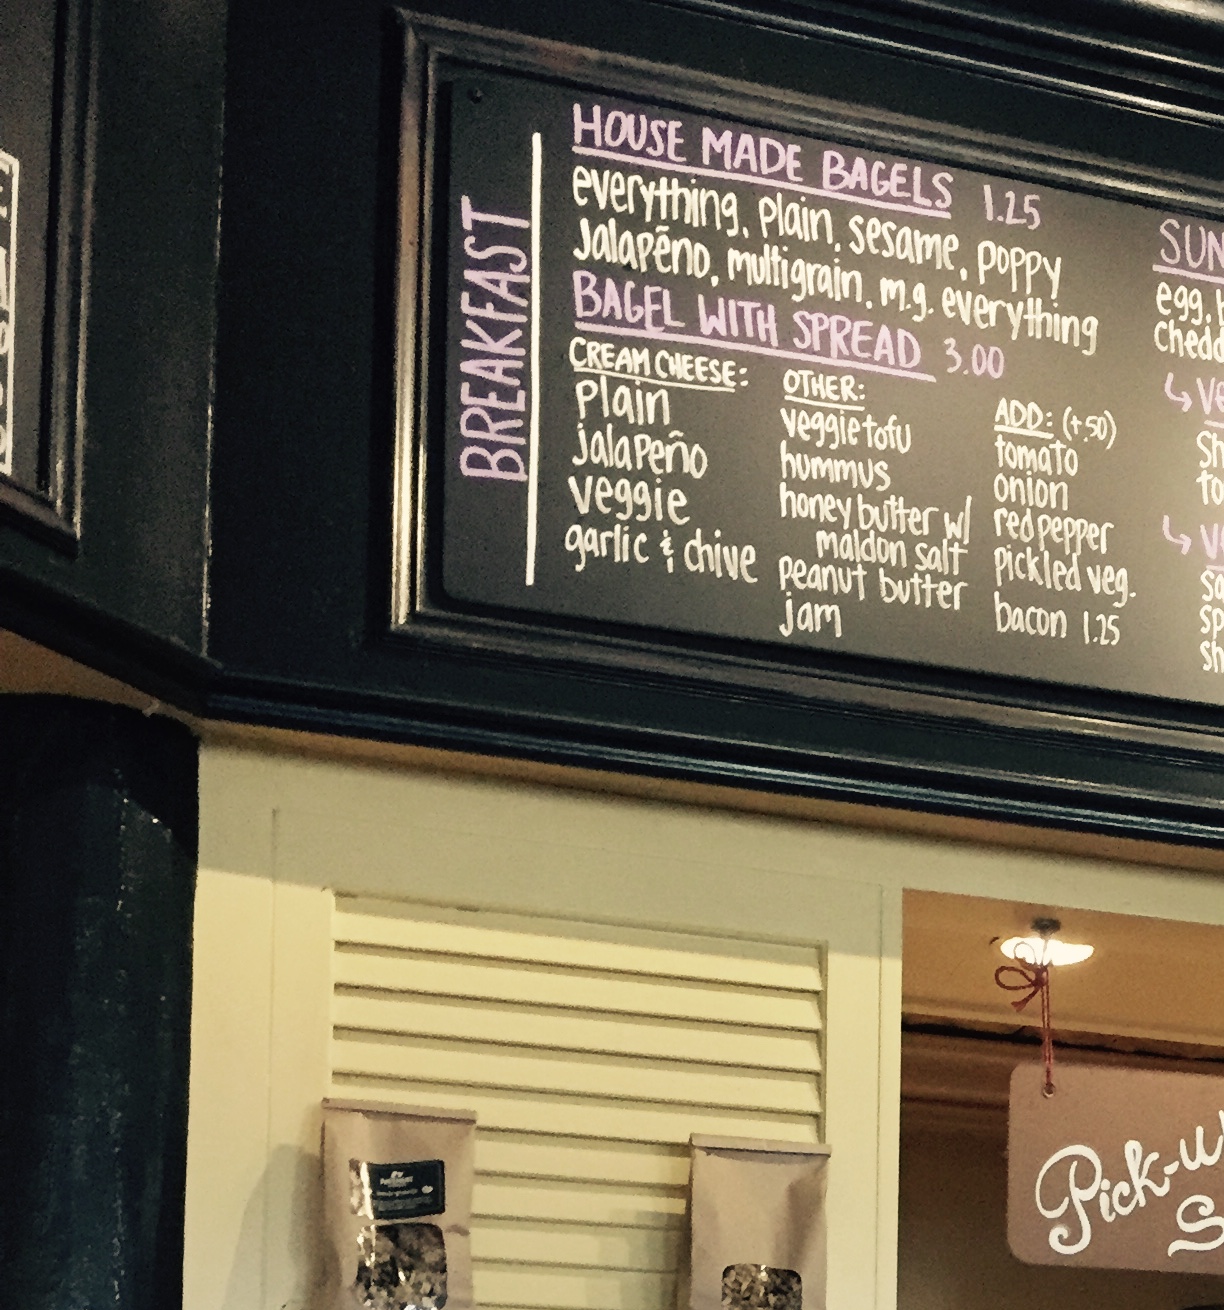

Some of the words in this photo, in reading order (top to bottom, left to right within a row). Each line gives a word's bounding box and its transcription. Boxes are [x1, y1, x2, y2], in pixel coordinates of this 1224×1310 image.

[573, 103, 686, 161] HOUSE
[702, 127, 802, 182] MADE
[822, 150, 954, 209] BAGELS
[984, 184, 1041, 230] 1.25
[978, 240, 1061, 299] poppy
[459, 194, 529, 482] BREAKFAST
[573, 270, 685, 330] BAGEL
[699, 294, 778, 346] WITH
[793, 310, 921, 369] SPREAD
[944, 338, 1005, 379] 3.00
[942, 286, 1098, 357] everything
[569, 337, 649, 375] CREAM
[655, 351, 749, 386] CHEESE:
[783, 369, 865, 401] OTHER:
[780, 407, 858, 449] veggie
[862, 413, 912, 453] tofu
[994, 397, 1053, 429] ADD:
[780, 440, 891, 491] hummus
[995, 434, 1079, 475] tomato
[568, 475, 690, 525] veggie
[780, 482, 852, 530] honey
[858, 494, 939, 535] butter
[994, 471, 1068, 510] onion
[564, 524, 649, 572] garlic
[684, 528, 758, 583] chive
[816, 528, 906, 568] maldon
[915, 538, 968, 575] salt
[994, 507, 1034, 542] red
[1038, 513, 1114, 555] pepper
[779, 555, 867, 600] peanut
[879, 568, 968, 609] butter
[994, 545, 1081, 592] pickled
[1087, 565, 1137, 608] veg.
[779, 592, 842, 637] jam
[994, 591, 1066, 638] bacon
[1083, 610, 1120, 645] 1.25
